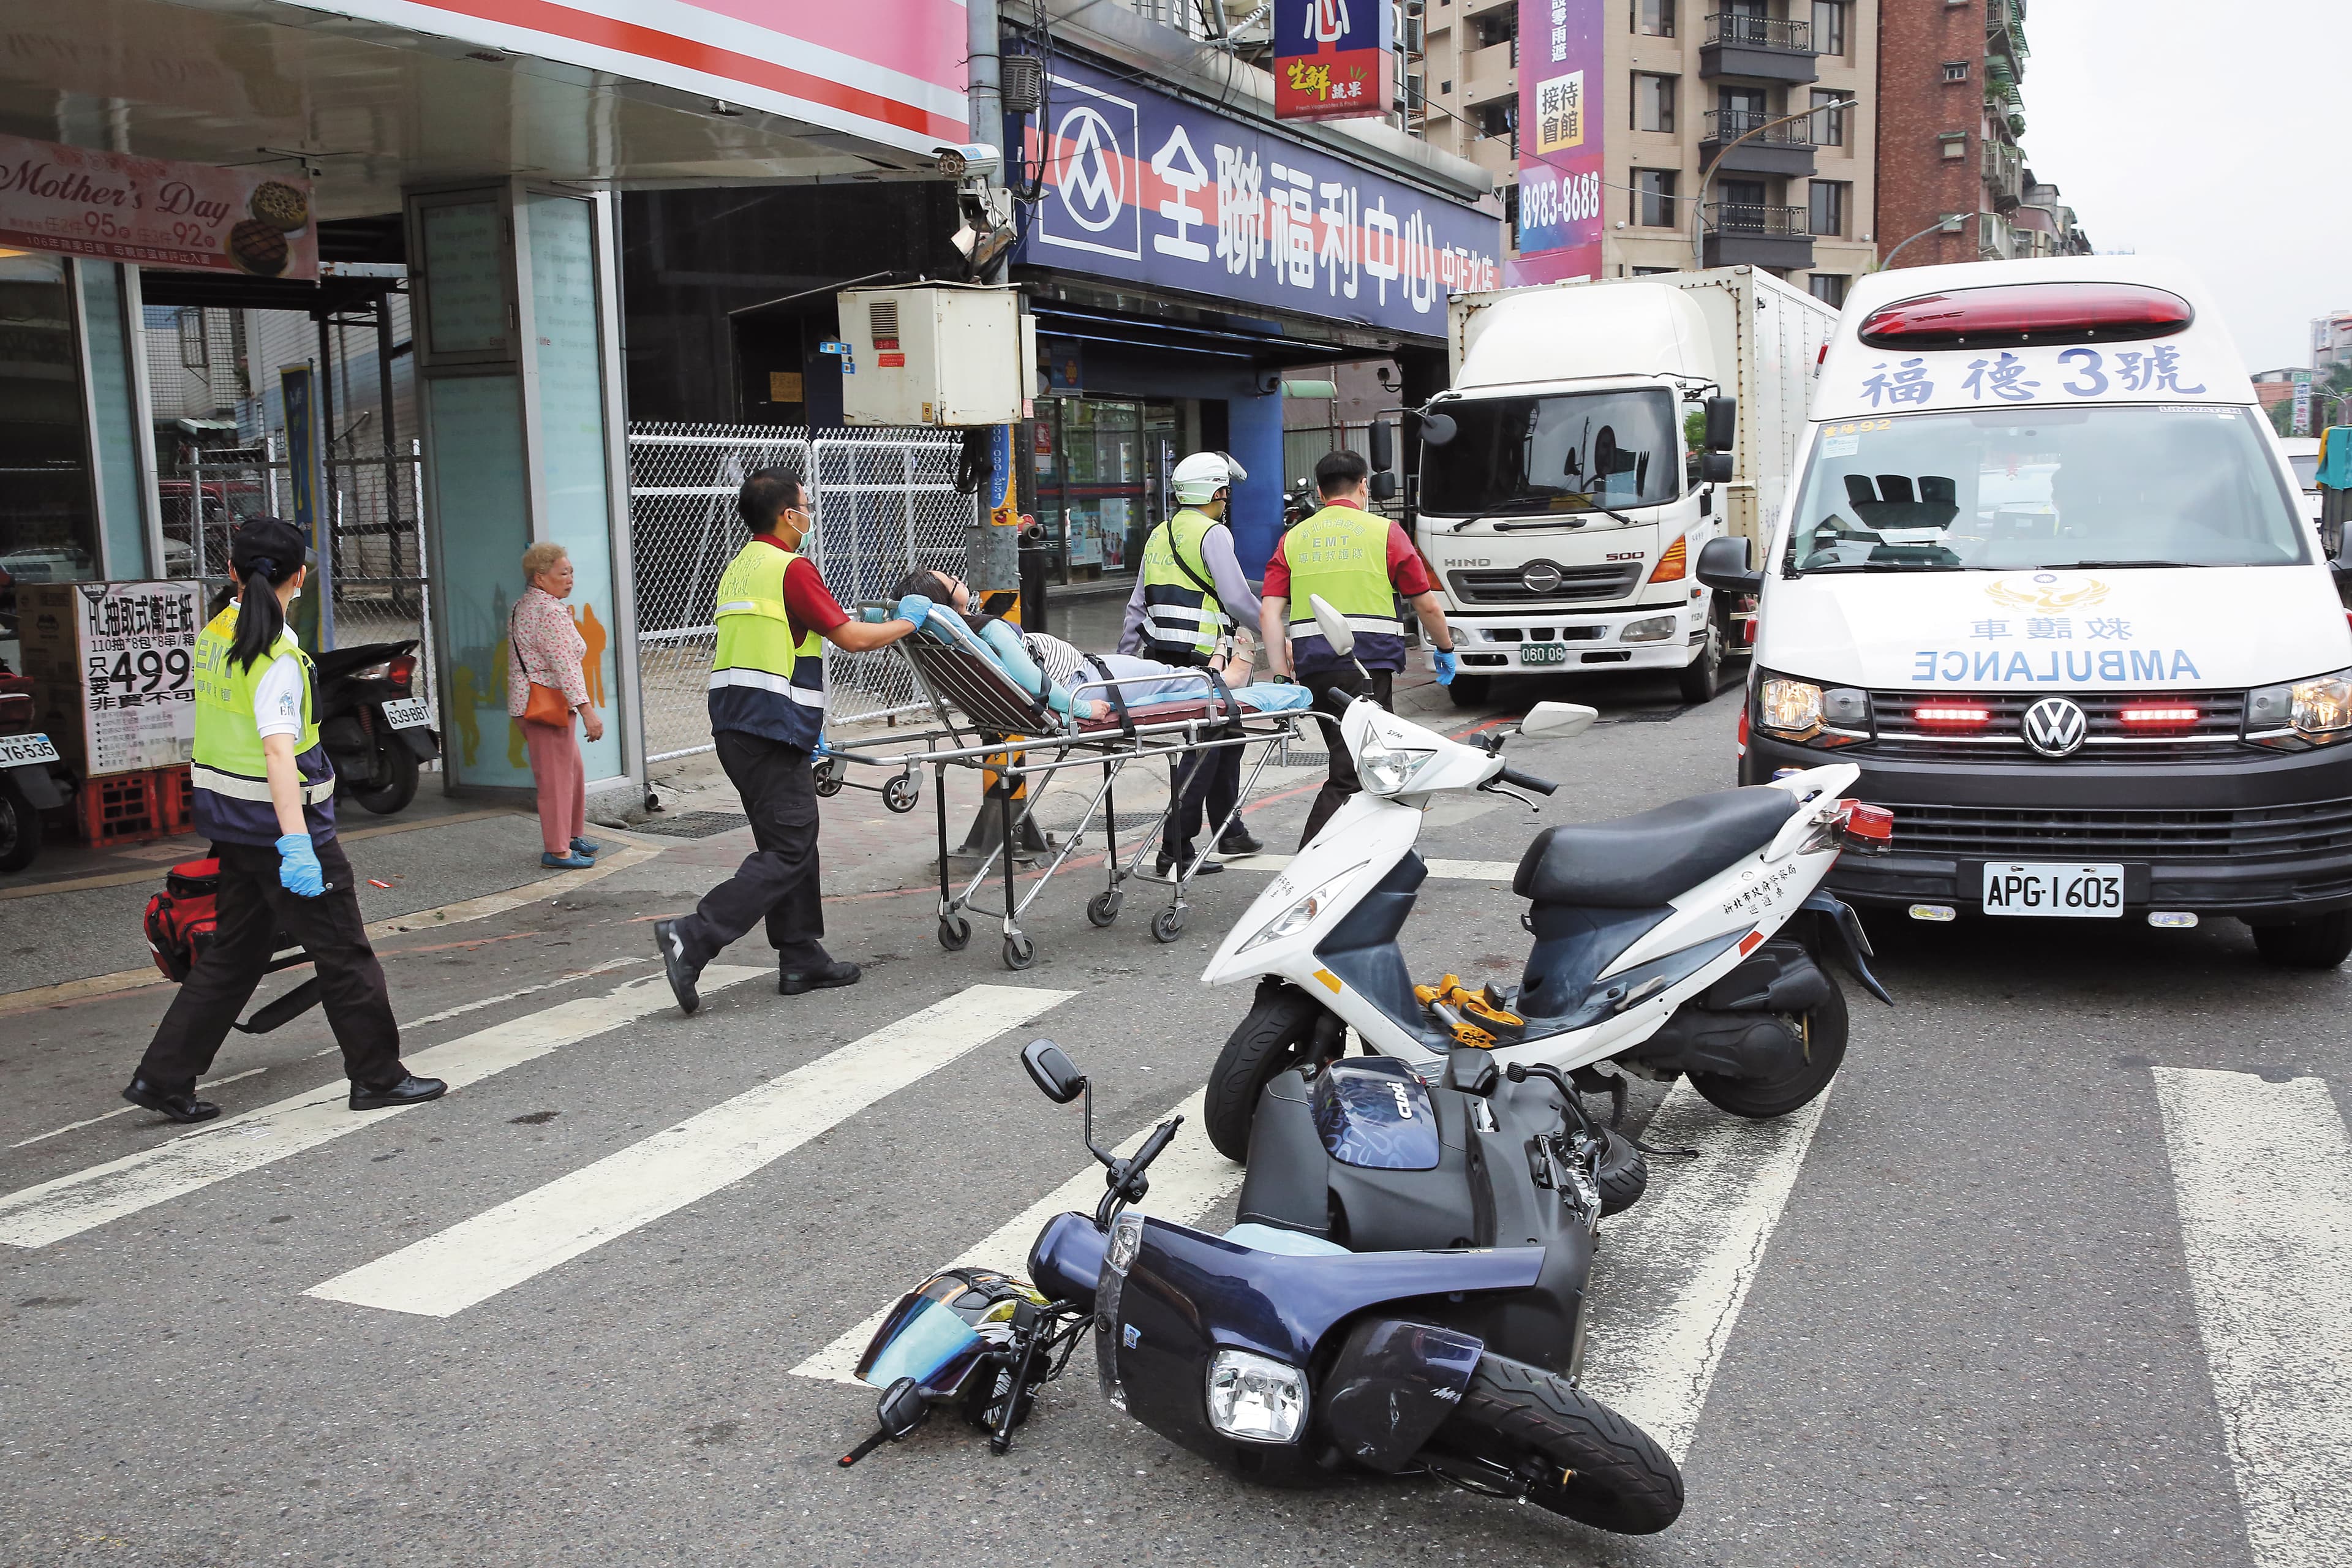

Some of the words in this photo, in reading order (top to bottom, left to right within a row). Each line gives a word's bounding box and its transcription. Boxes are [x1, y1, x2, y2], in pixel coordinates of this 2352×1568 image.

[1287, 58, 1332, 101] 生鮮
[1332, 81, 1362, 99] 蔬果
[1312, 102, 1339, 111] Vegetables
[1542, 81, 1578, 115] 接待
[1542, 110, 1578, 145] 會館
[0, 160, 143, 209] Mother's
[156, 181, 230, 228] Day
[1523, 171, 1599, 230] 8983-8688
[1151, 124, 1437, 314] 全聯福利中心
[1442, 241, 1494, 294] 中正北店
[1313, 535, 1349, 548] EMT
[1605, 551, 1645, 561] 500
[1444, 557, 1491, 567] HINO
[88, 594, 194, 638] HL抽取式衛生紙
[88, 656, 110, 696] 只要
[109, 648, 190, 693] 499
[89, 689, 195, 711] 非買不可
[388, 706, 430, 725] 639-BBT
[1387, 729, 1403, 740] SYM
[0, 742, 55, 762] Y6-535
[1723, 864, 1797, 915] 新北市政府警察局
[1987, 875, 2120, 908] APG-1603
